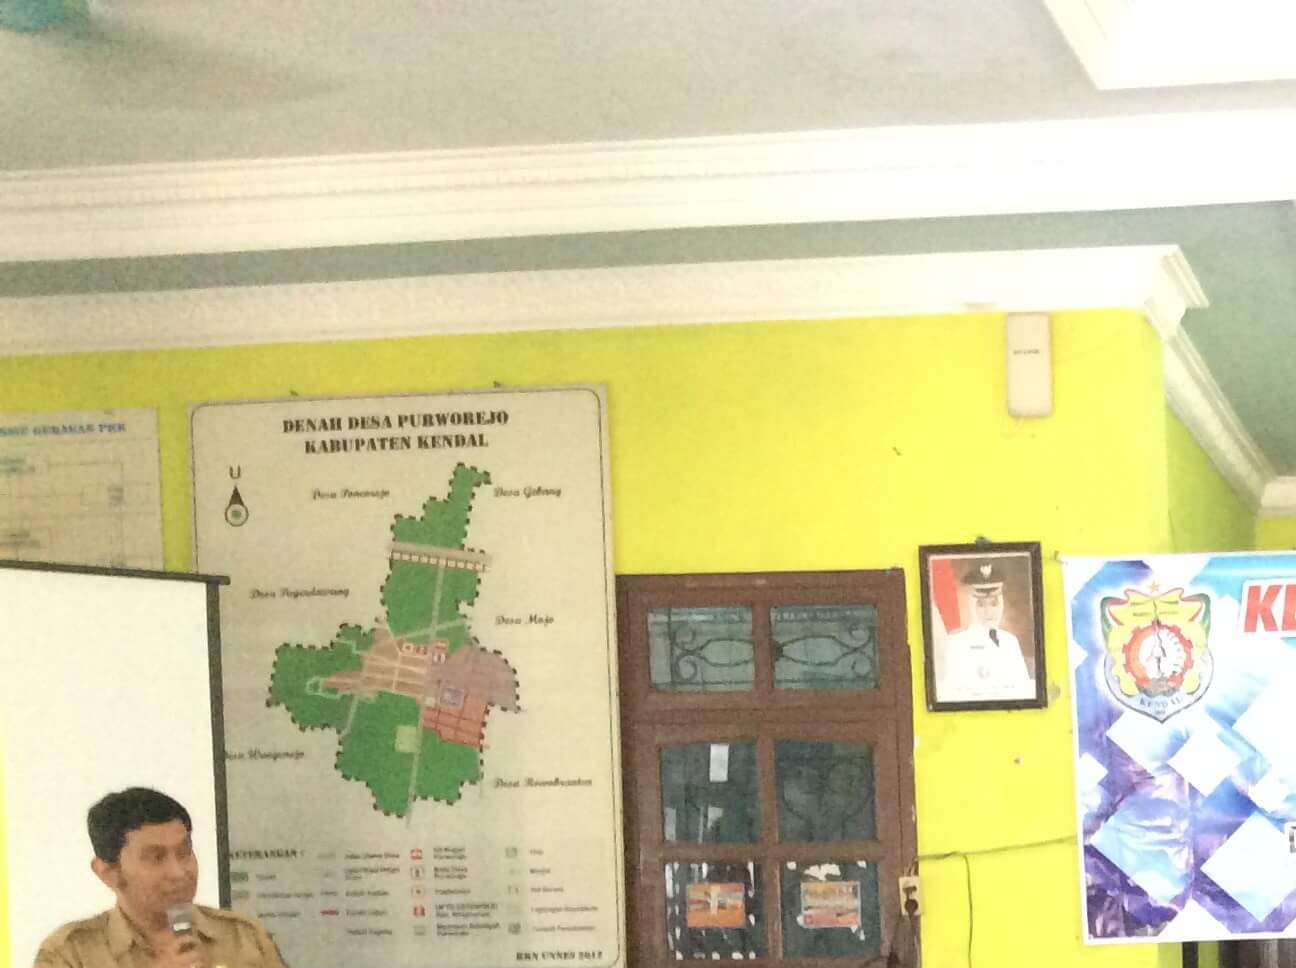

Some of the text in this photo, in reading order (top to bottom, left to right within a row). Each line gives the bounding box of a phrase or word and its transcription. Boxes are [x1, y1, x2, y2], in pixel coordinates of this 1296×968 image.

[283, 410, 509, 433] DENAH DESA PURWOREJO
[304, 433, 489, 454] KABUPATEN KENDAL
[496, 615, 521, 626] Desa
